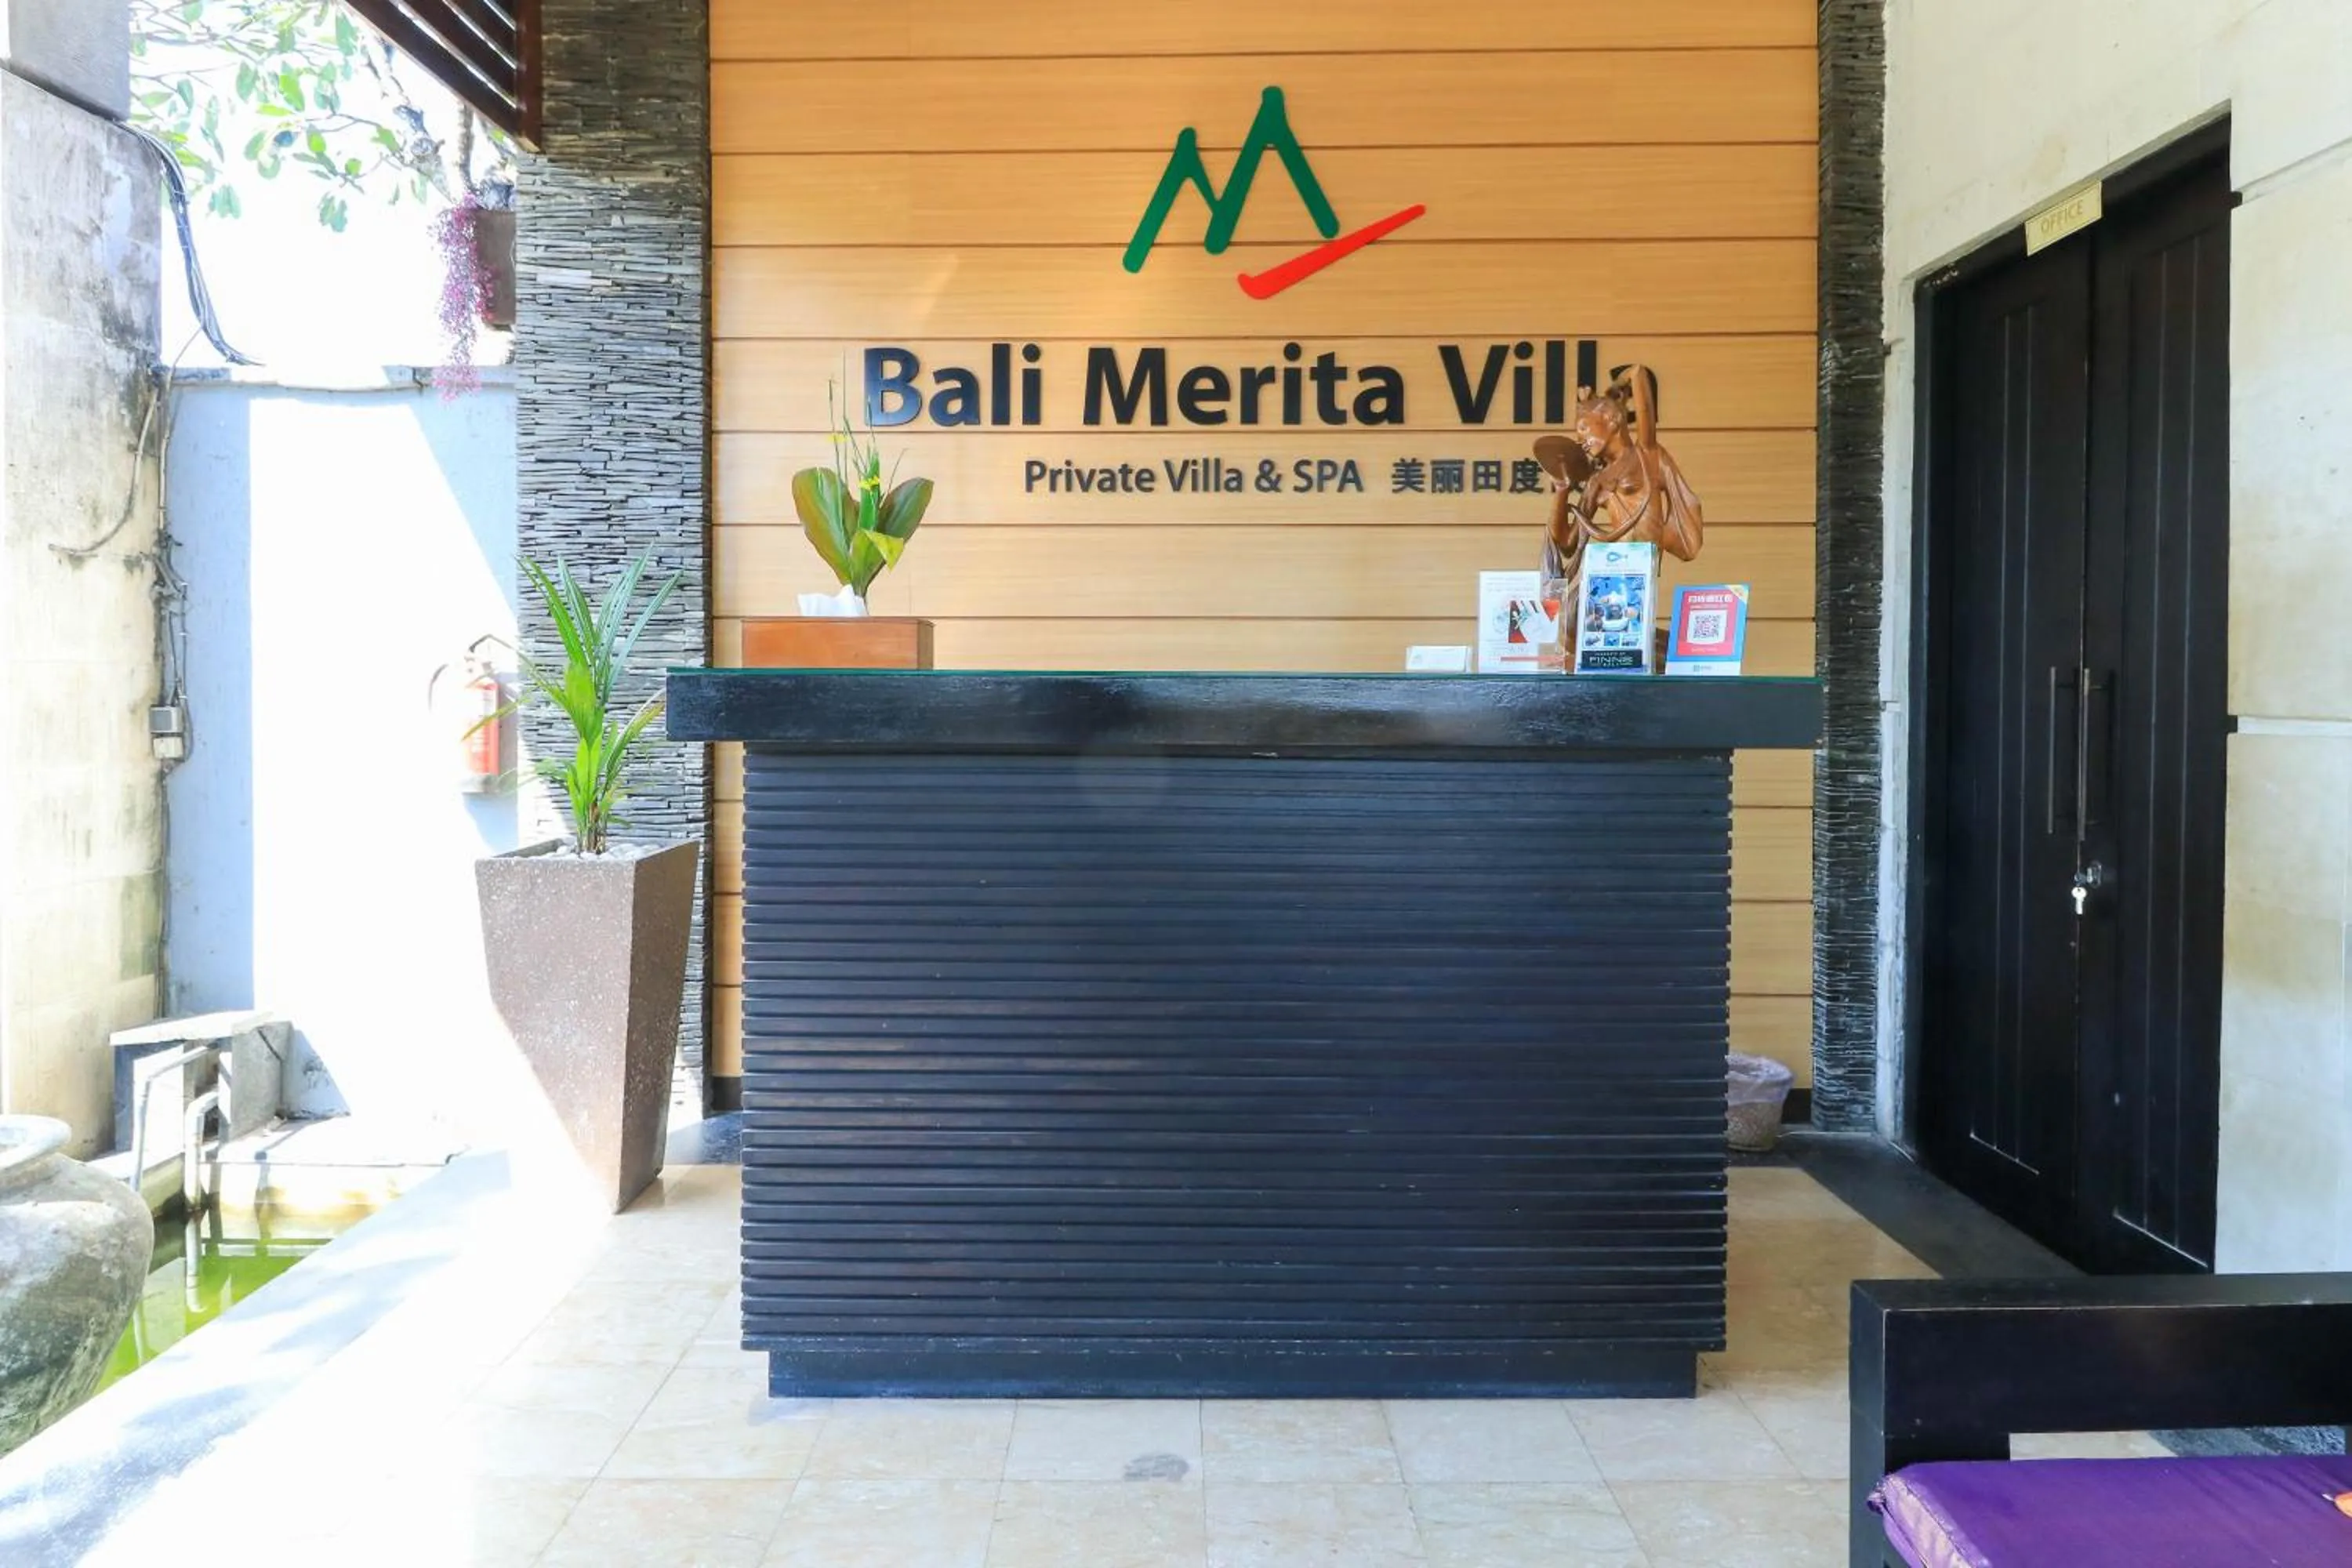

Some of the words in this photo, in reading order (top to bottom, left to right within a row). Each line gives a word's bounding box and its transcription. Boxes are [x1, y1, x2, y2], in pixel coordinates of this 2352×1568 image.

[864, 343, 1041, 426] Bali
[1083, 343, 1406, 426] Merita
[1025, 459, 1156, 492] Private
[1163, 458, 1243, 492] Villa
[1254, 459, 1282, 493] &
[1294, 459, 1364, 492] SPA
[1392, 457, 1603, 493] 美丽田度
